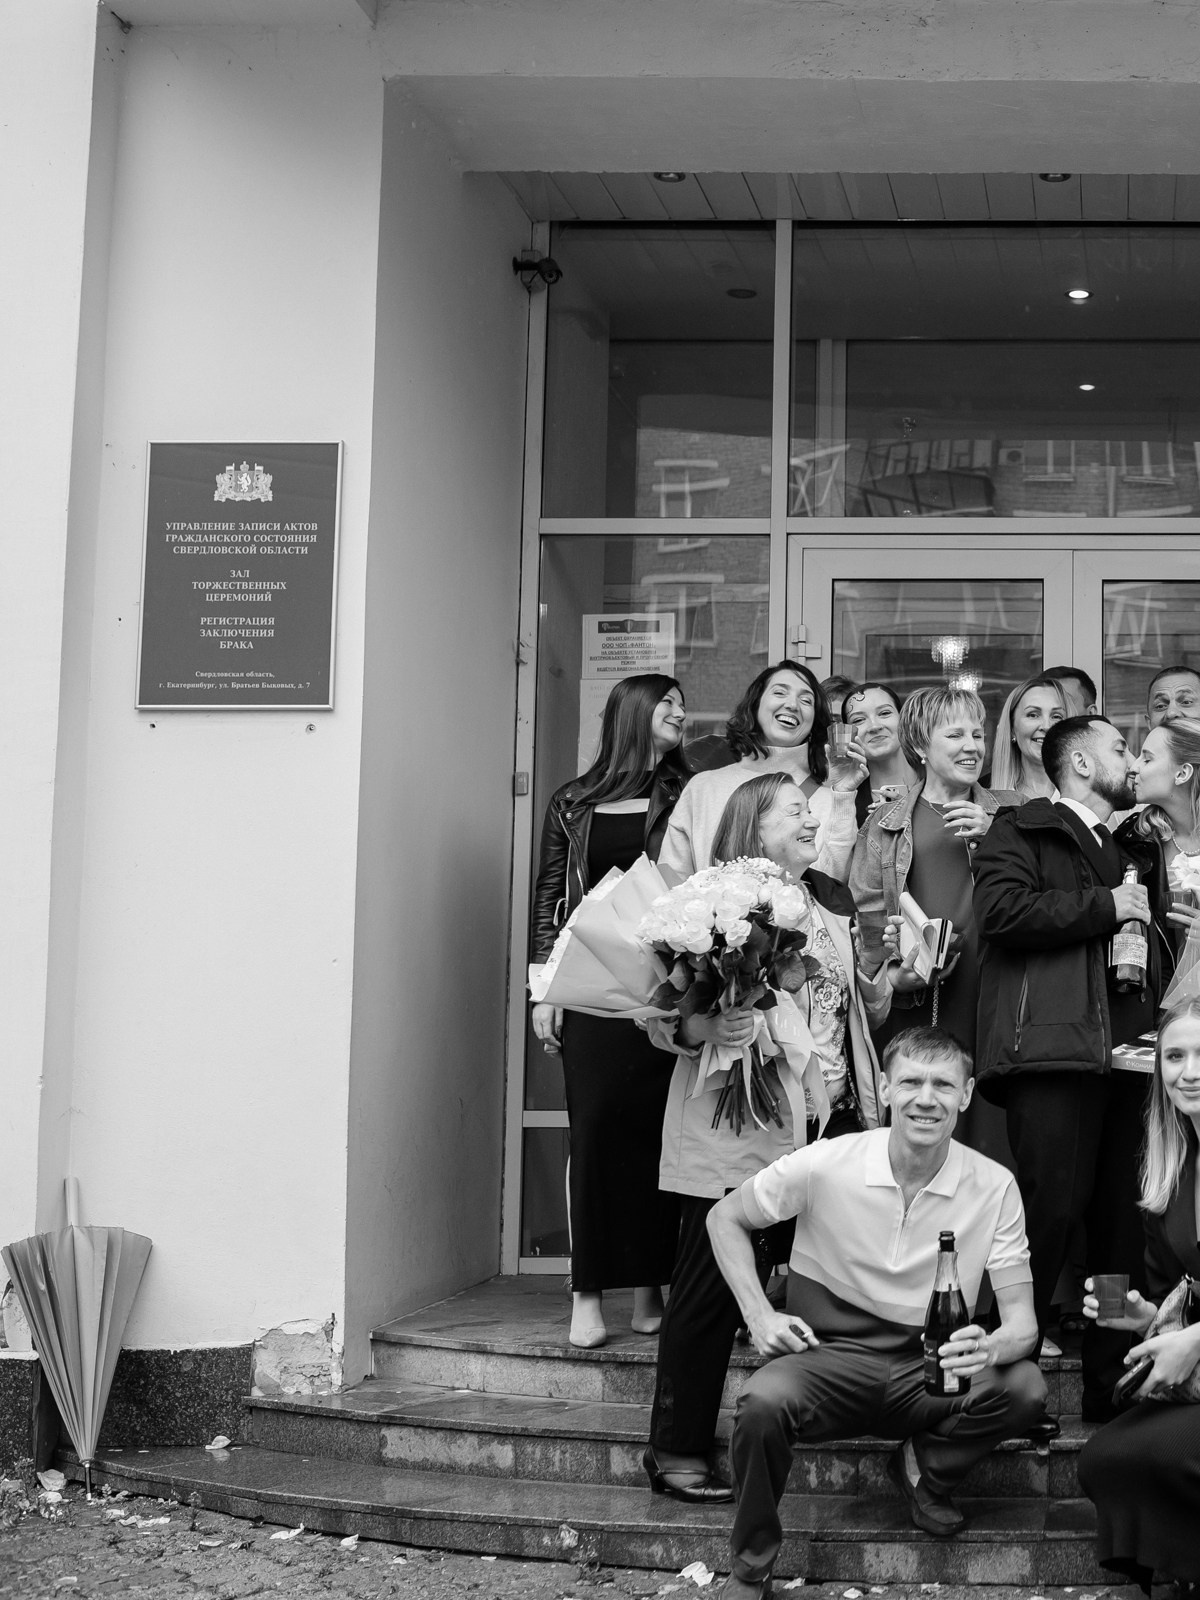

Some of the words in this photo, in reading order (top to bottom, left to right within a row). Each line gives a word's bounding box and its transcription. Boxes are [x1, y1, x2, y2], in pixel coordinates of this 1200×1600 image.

[165, 522, 236, 531] УПРАВЛЕНИЕ
[238, 522, 281, 531] ЗАПИСИ
[283, 522, 318, 531] АКТОВ
[165, 533, 251, 543] ГРАЖДАНСКОГО
[253, 533, 317, 543] СОСТОЯНИЯ
[173, 544, 257, 555] СВЕРДЛОВСКОЙ
[259, 545, 309, 555] ОБЛАСТИ
[229, 569, 250, 579] ЗАЛ
[192, 581, 287, 590] ТОРЖЕСТВЕННЫХ
[205, 591, 273, 603] ЦЕРЕМОНИЙ
[200, 616, 275, 627] РЕГИСТРАЦИЯ
[199, 628, 275, 638] ЗАКЛЮЧЕНИЯ
[219, 640, 254, 650] БРАКА
[195, 670, 244, 679] Свердловская
[245, 671, 275, 679] область,
[166, 681, 217, 690] Екатеринбург,
[218, 682, 230, 690] ул.
[231, 681, 260, 690] Братьев
[261, 682, 296, 690] Быковых,
[297, 682, 304, 690] д.
[306, 681, 311, 689] 7
